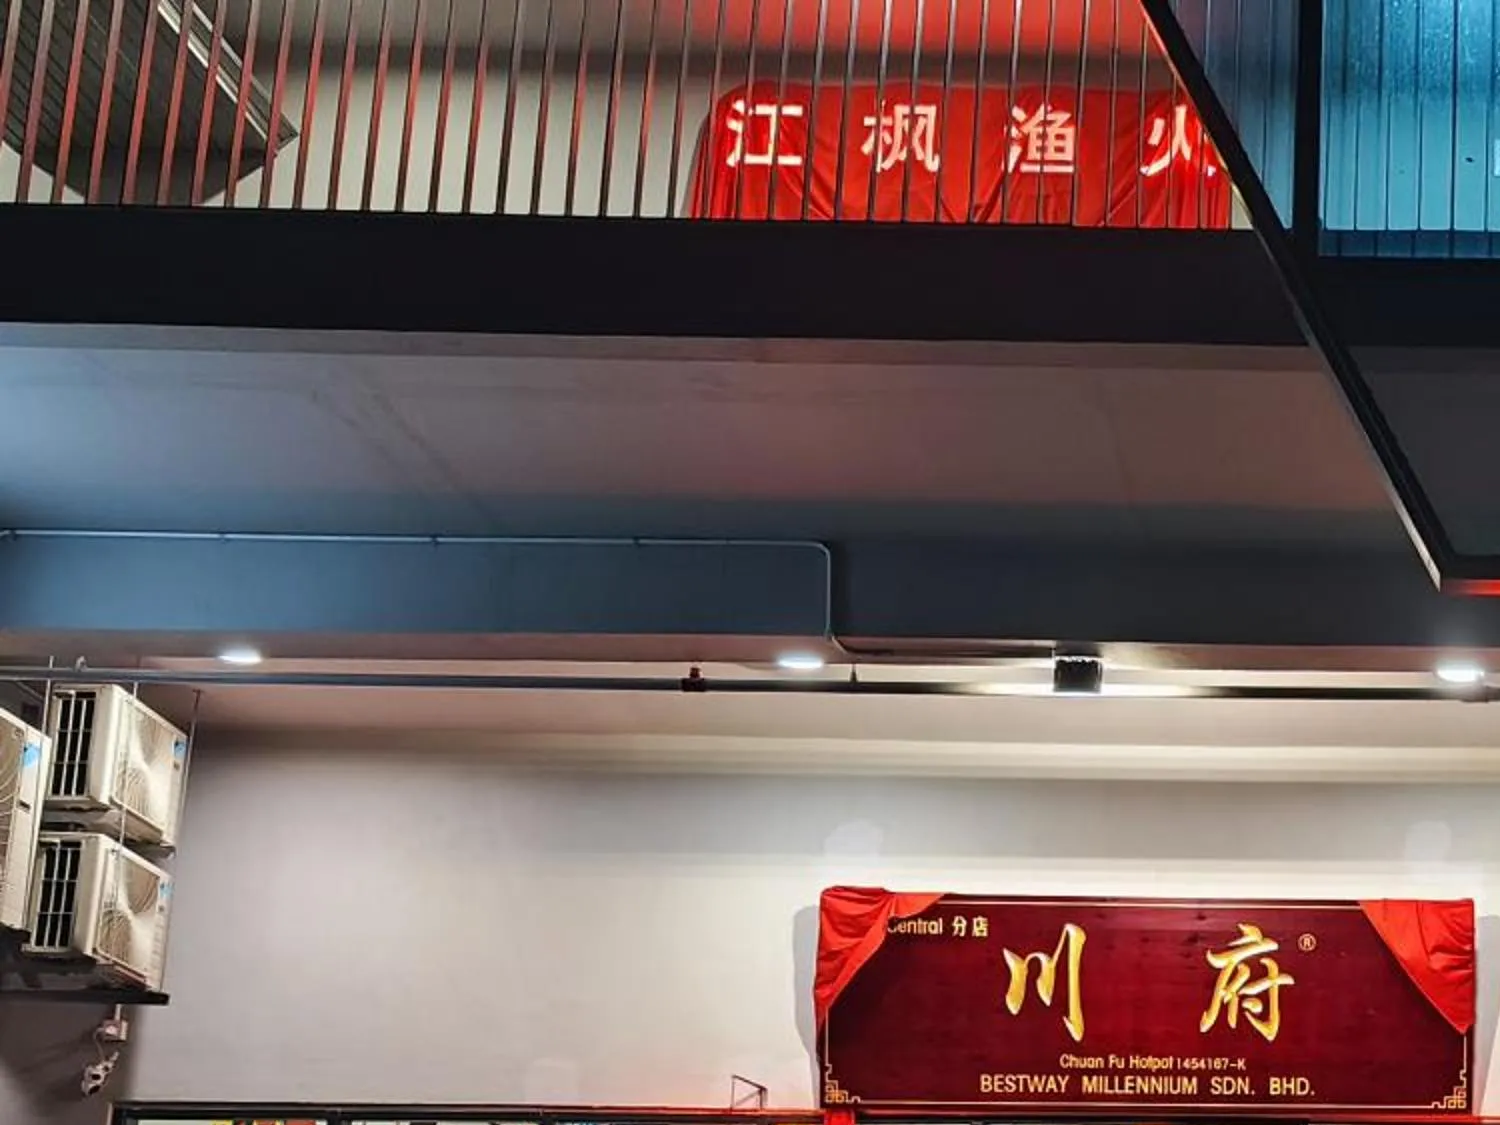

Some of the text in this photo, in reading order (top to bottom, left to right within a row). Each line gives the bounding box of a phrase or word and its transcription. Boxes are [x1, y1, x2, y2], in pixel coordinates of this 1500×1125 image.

[952, 915, 988, 937] 分店
[1002, 923, 1295, 1041] 川府
[1060, 1054, 1104, 1069] Chuan
[1109, 1054, 1125, 1069] Fu
[1129, 1054, 1174, 1071] Hotpot
[980, 1074, 1315, 1096] BESTWAY MILLENNIUM SDN. BHD.
